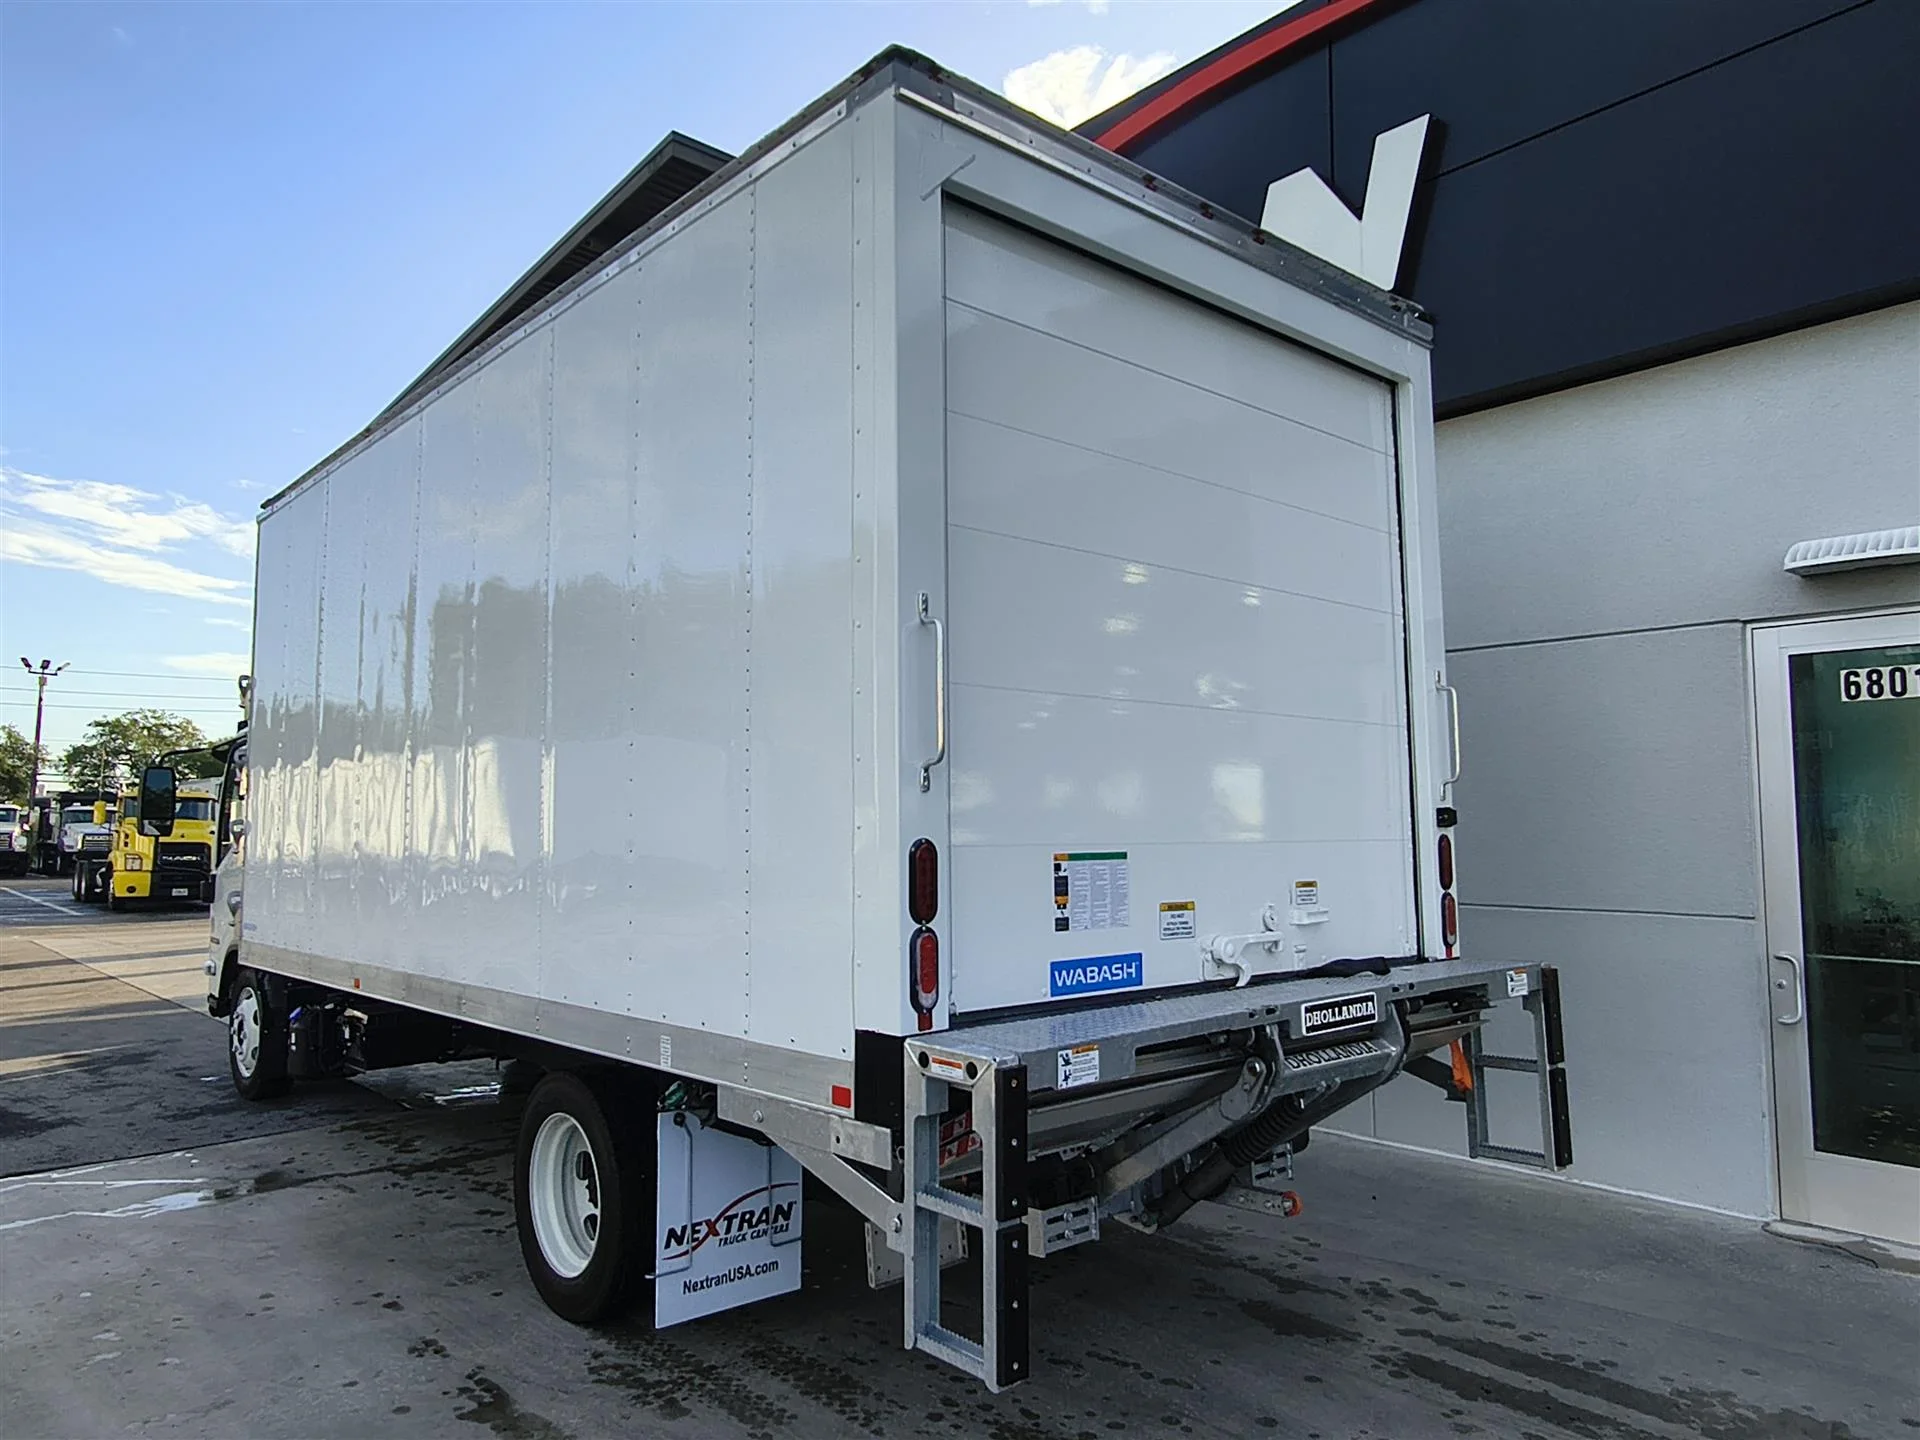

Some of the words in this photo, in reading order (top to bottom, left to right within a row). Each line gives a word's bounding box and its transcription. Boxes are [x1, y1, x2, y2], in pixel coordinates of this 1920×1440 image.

[1844, 666, 1920, 700] 680
[1054, 961, 1136, 987] WABASH
[1306, 1001, 1375, 1027] DHOLLANDIA
[1284, 1041, 1378, 1069] DHOLLANDIA
[664, 1202, 793, 1249] NEXTRAN
[718, 1232, 747, 1247] TRUCK
[750, 1223, 789, 1240] CENERS
[683, 1260, 779, 1295] NextranUSA.com
